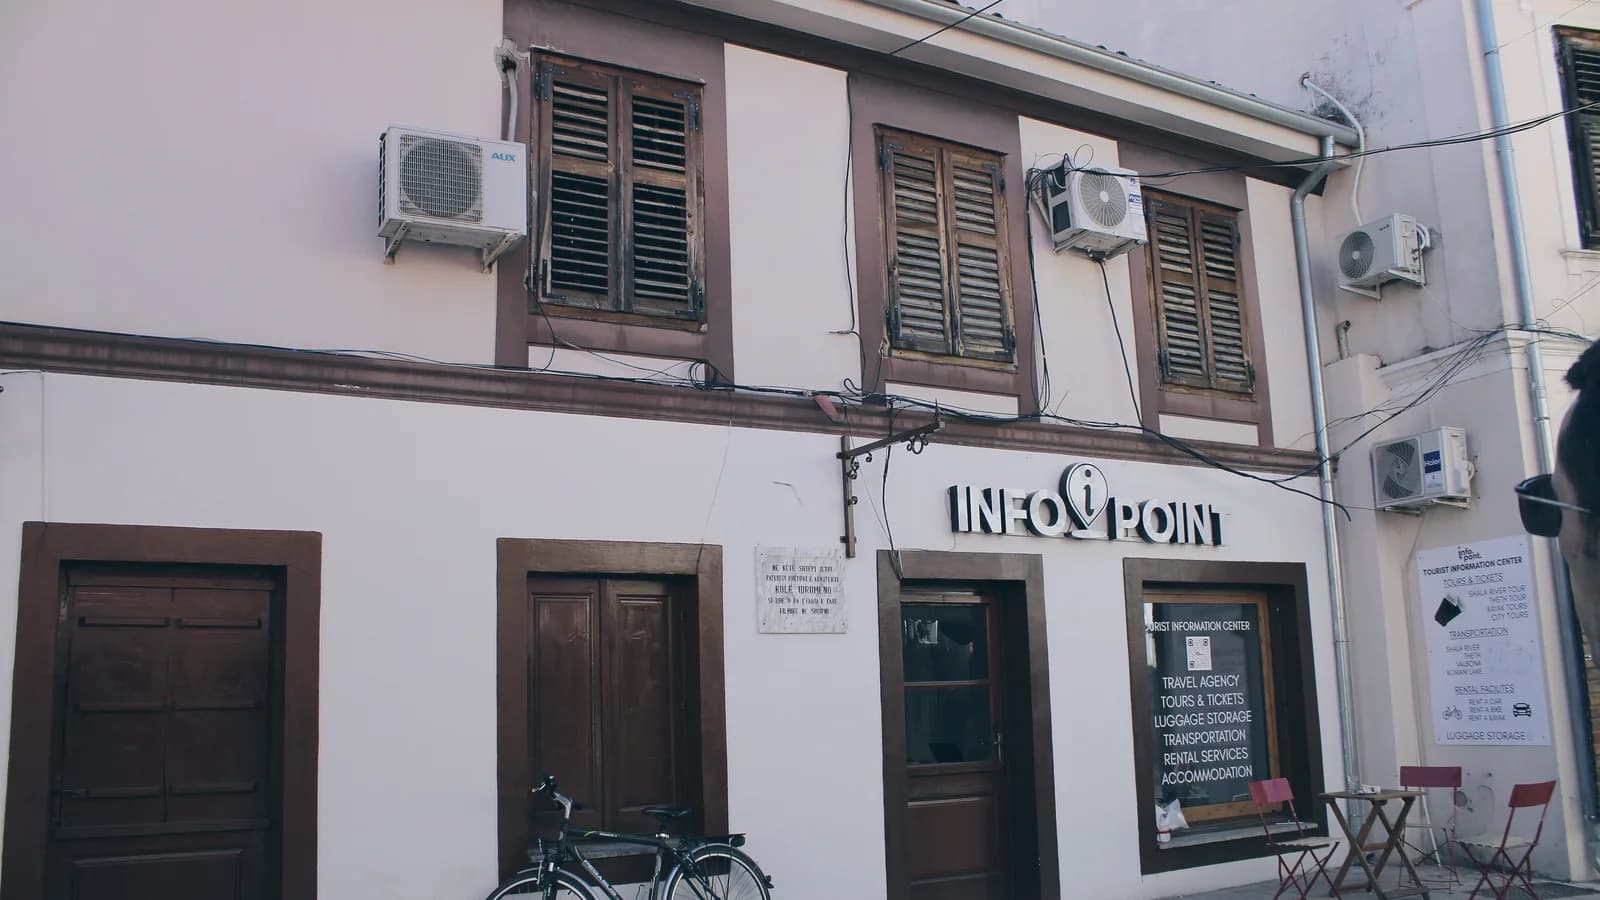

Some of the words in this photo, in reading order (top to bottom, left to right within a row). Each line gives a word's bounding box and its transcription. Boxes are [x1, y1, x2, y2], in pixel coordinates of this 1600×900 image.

[490, 152, 516, 162] AUX
[948, 484, 1067, 538] INFO
[1108, 496, 1225, 546] POINT
[1423, 566, 1449, 576] TOURIST
[1450, 560, 1495, 573] INFORMATION
[1497, 556, 1522, 566] CENTER
[1443, 577, 1466, 587] TOURS
[1475, 572, 1503, 584] TICKETS
[1489, 587, 1507, 595] RIVER
[1507, 585, 1526, 593] TOUR
[1508, 593, 1527, 601] TOUR
[1506, 602, 1528, 611] TOURS
[1506, 611, 1529, 620] TOURS
[1144, 621, 1170, 632] OURIST
[1171, 621, 1222, 632] INFORMATION
[1223, 620, 1251, 631] CENTER
[1449, 627, 1509, 638] TRANSPORTATION
[1162, 675, 1198, 689] TRAVEL
[1200, 674, 1240, 688] AGENCY
[1455, 685, 1479, 694] RENTAL
[1160, 694, 1194, 709] TOURS
[1197, 694, 1205, 707] &
[1206, 692, 1245, 707] TICKETS
[1154, 713, 1205, 728] LUGGAGE
[1206, 710, 1253, 725] STORAGE
[1163, 728, 1247, 747] TRANSPORTATION
[1446, 731, 1485, 741] LUGGAGE
[1486, 731, 1527, 741] STORAGE
[1163, 751, 1200, 766] RENTAL
[1201, 747, 1249, 763] SERVICES
[1161, 765, 1253, 786] ACCOMMODATION
